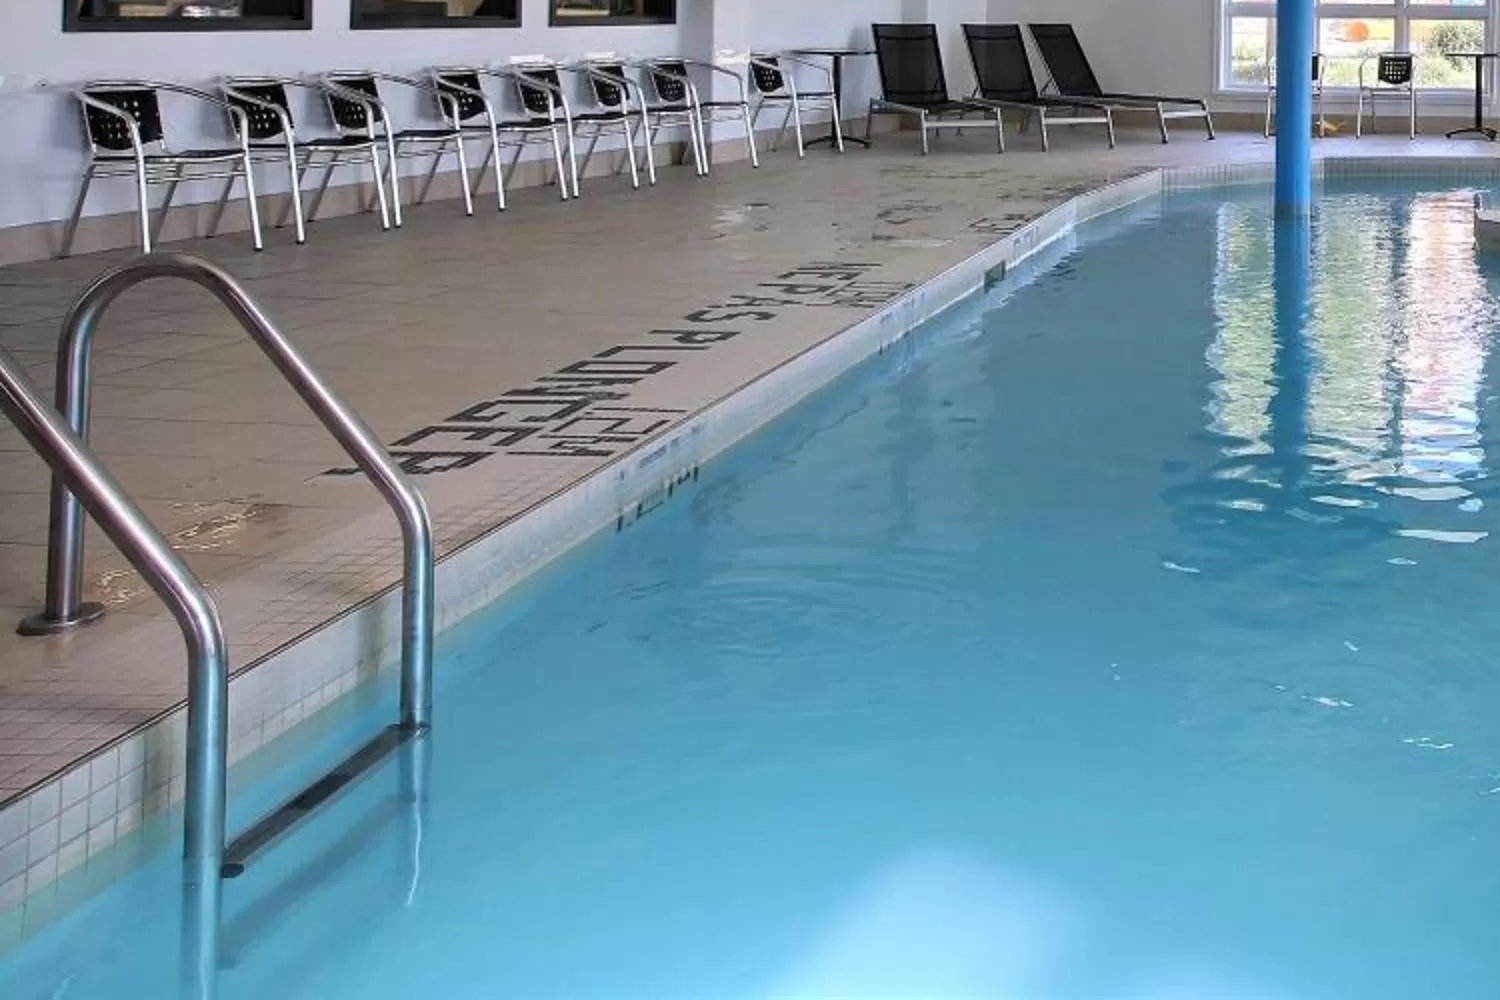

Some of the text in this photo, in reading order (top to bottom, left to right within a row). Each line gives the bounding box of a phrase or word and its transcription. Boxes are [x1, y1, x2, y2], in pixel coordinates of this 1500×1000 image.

[683, 282, 842, 324] PAS
[320, 330, 741, 476] PLONGER
[506, 406, 688, 457] 1.2M
